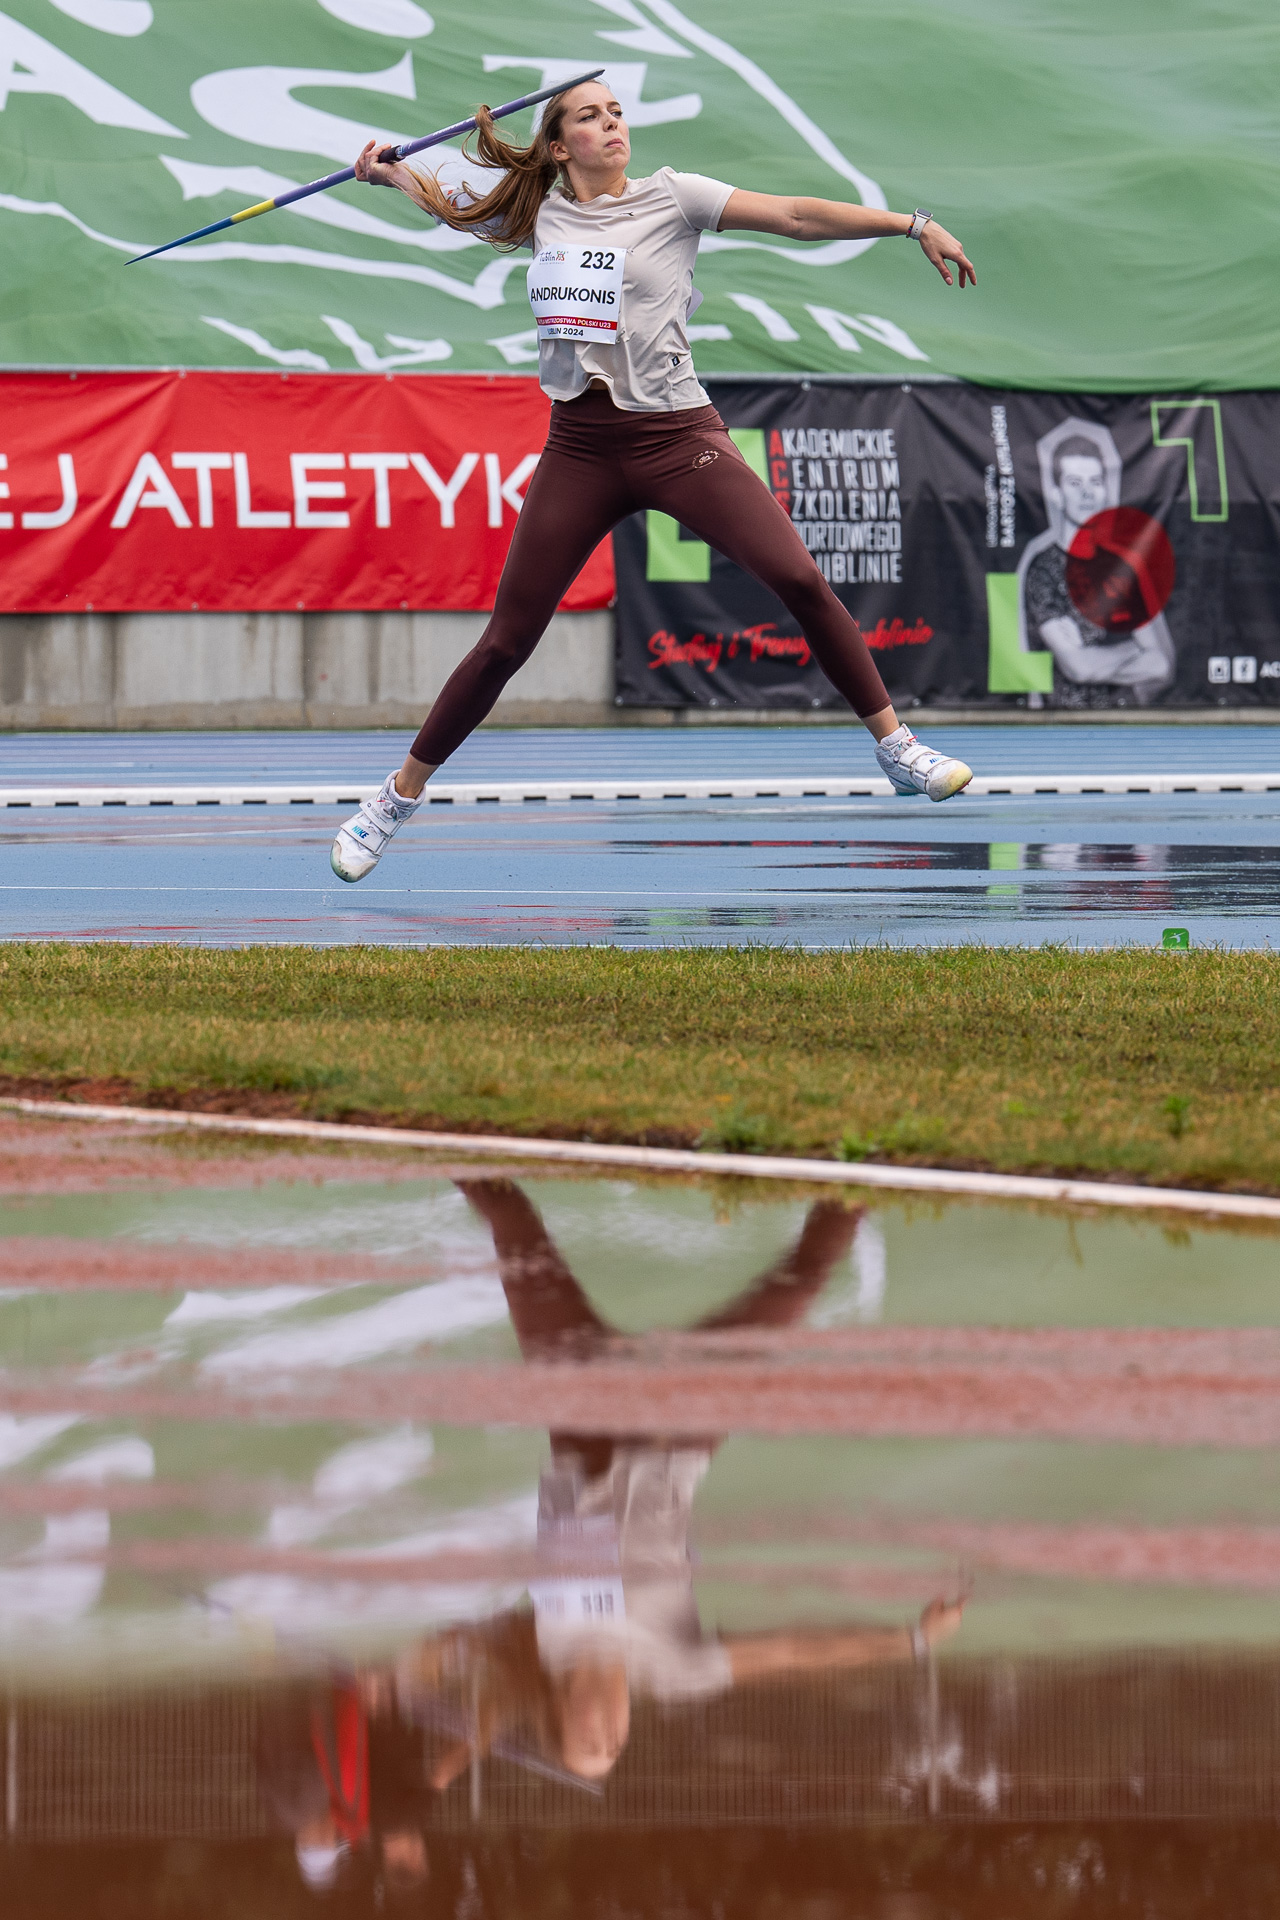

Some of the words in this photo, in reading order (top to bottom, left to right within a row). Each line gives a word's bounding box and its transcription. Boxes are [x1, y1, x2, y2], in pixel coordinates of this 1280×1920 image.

[580, 251, 615, 270] 232
[531, 287, 615, 304] ANDRUKONIS
[562, 328, 584, 336] 2024
[577, 319, 599, 327] POLSKI
[769, 428, 897, 459] AKADEMICKIE
[771, 458, 899, 490] CENTRUM
[815, 552, 903, 583] UBLINIE
[353, 826, 368, 838] NIKE
